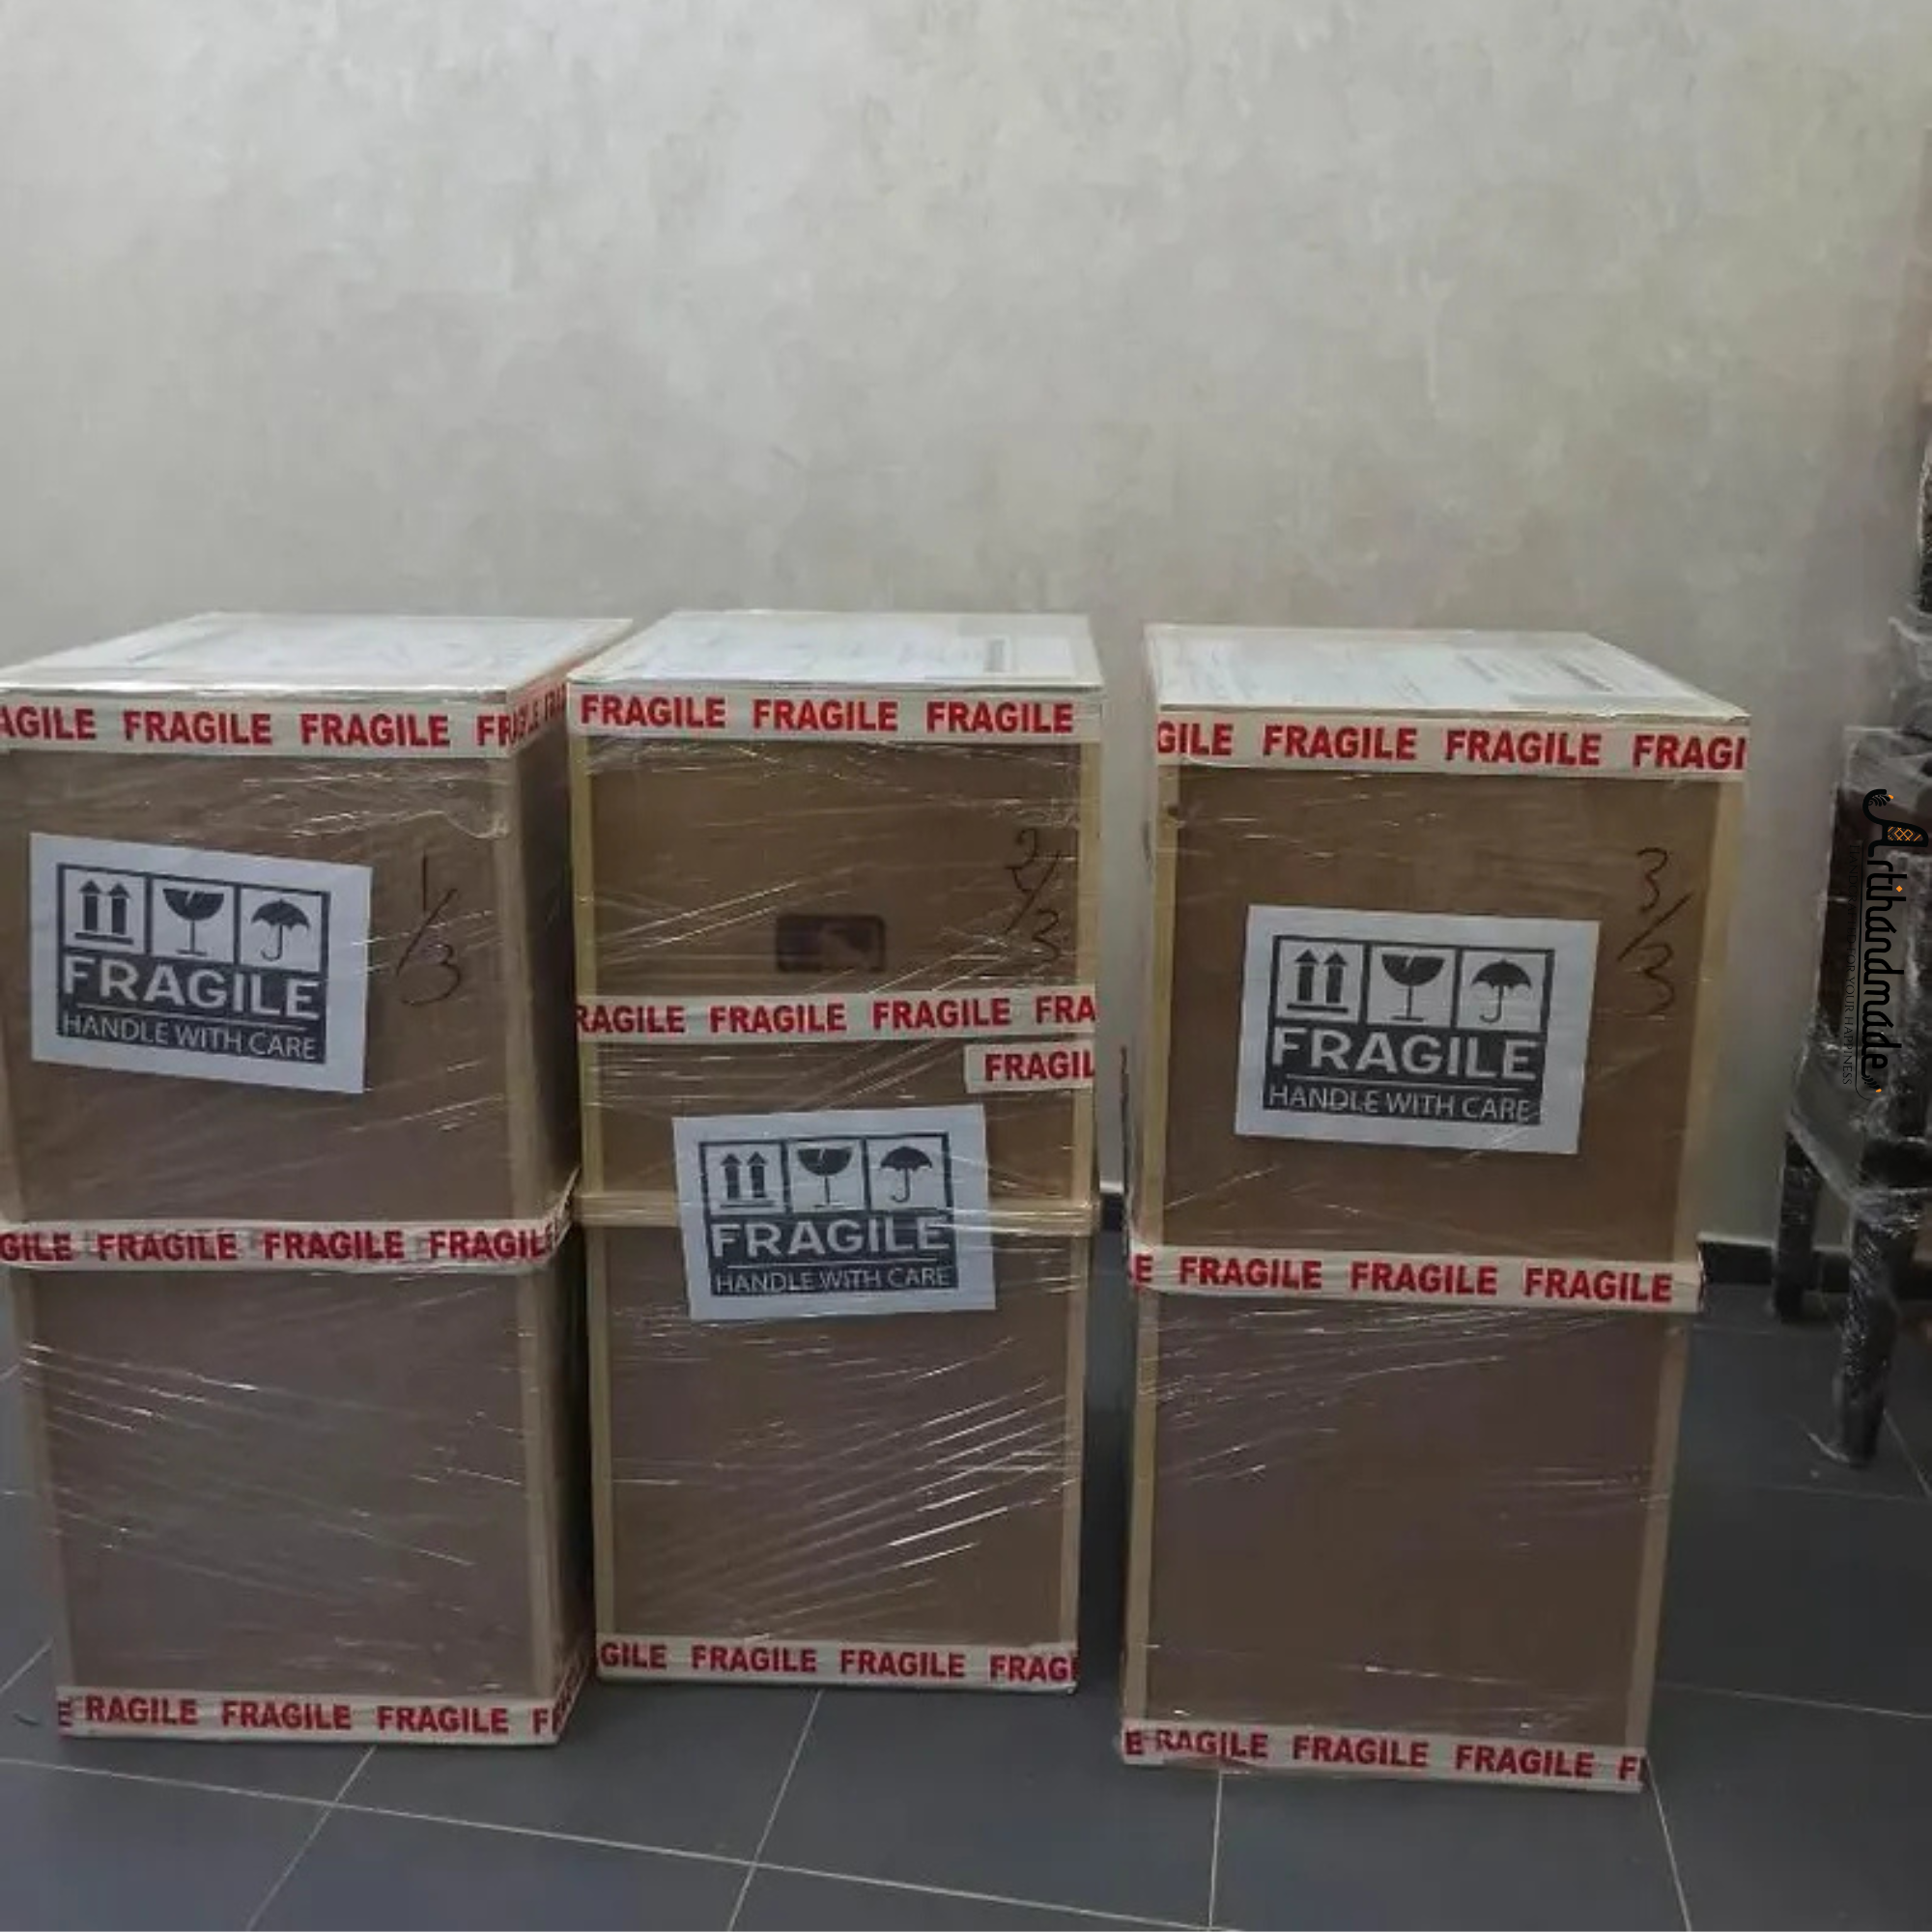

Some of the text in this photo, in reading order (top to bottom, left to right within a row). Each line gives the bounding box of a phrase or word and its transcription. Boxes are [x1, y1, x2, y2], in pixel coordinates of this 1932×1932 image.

[123, 710, 272, 745] FRAGILE
[300, 714, 447, 748] FRAGILE
[582, 695, 1072, 733] FRAGILE FRAGILE FRAGILE
[1157, 722, 1746, 770] GILE FRAGILE FRAGILE FRAGI
[63, 954, 320, 1020] FRAGILE
[710, 1004, 846, 1034] FRAGILE
[873, 998, 1009, 1030] FRAGILE
[63, 1013, 316, 1060] HANDLE WITH CARE
[1271, 1026, 1538, 1081] FRAGILE
[985, 1049, 1094, 1082] FRAGIL
[1268, 1084, 1529, 1122] HANDLE WITH CARE
[98, 1232, 237, 1262] FRAGILE
[264, 1230, 405, 1260] FRAGILE
[710, 1215, 950, 1257] FRAGILE
[716, 1266, 950, 1294] HANDLE WITH CARE
[1179, 1257, 1321, 1290] FRAGILE
[1350, 1262, 1497, 1295] FRAGILE
[1524, 1267, 1671, 1303] FRAGILE
[692, 1645, 816, 1672] FRAGILE
[840, 1650, 964, 1678] FRAGILE
[221, 1700, 351, 1729] FRAGILE
[377, 1707, 507, 1734] FRAGILE
[1293, 1735, 1427, 1768] FRAGILE
[1456, 1745, 1593, 1777] FRAGILE
